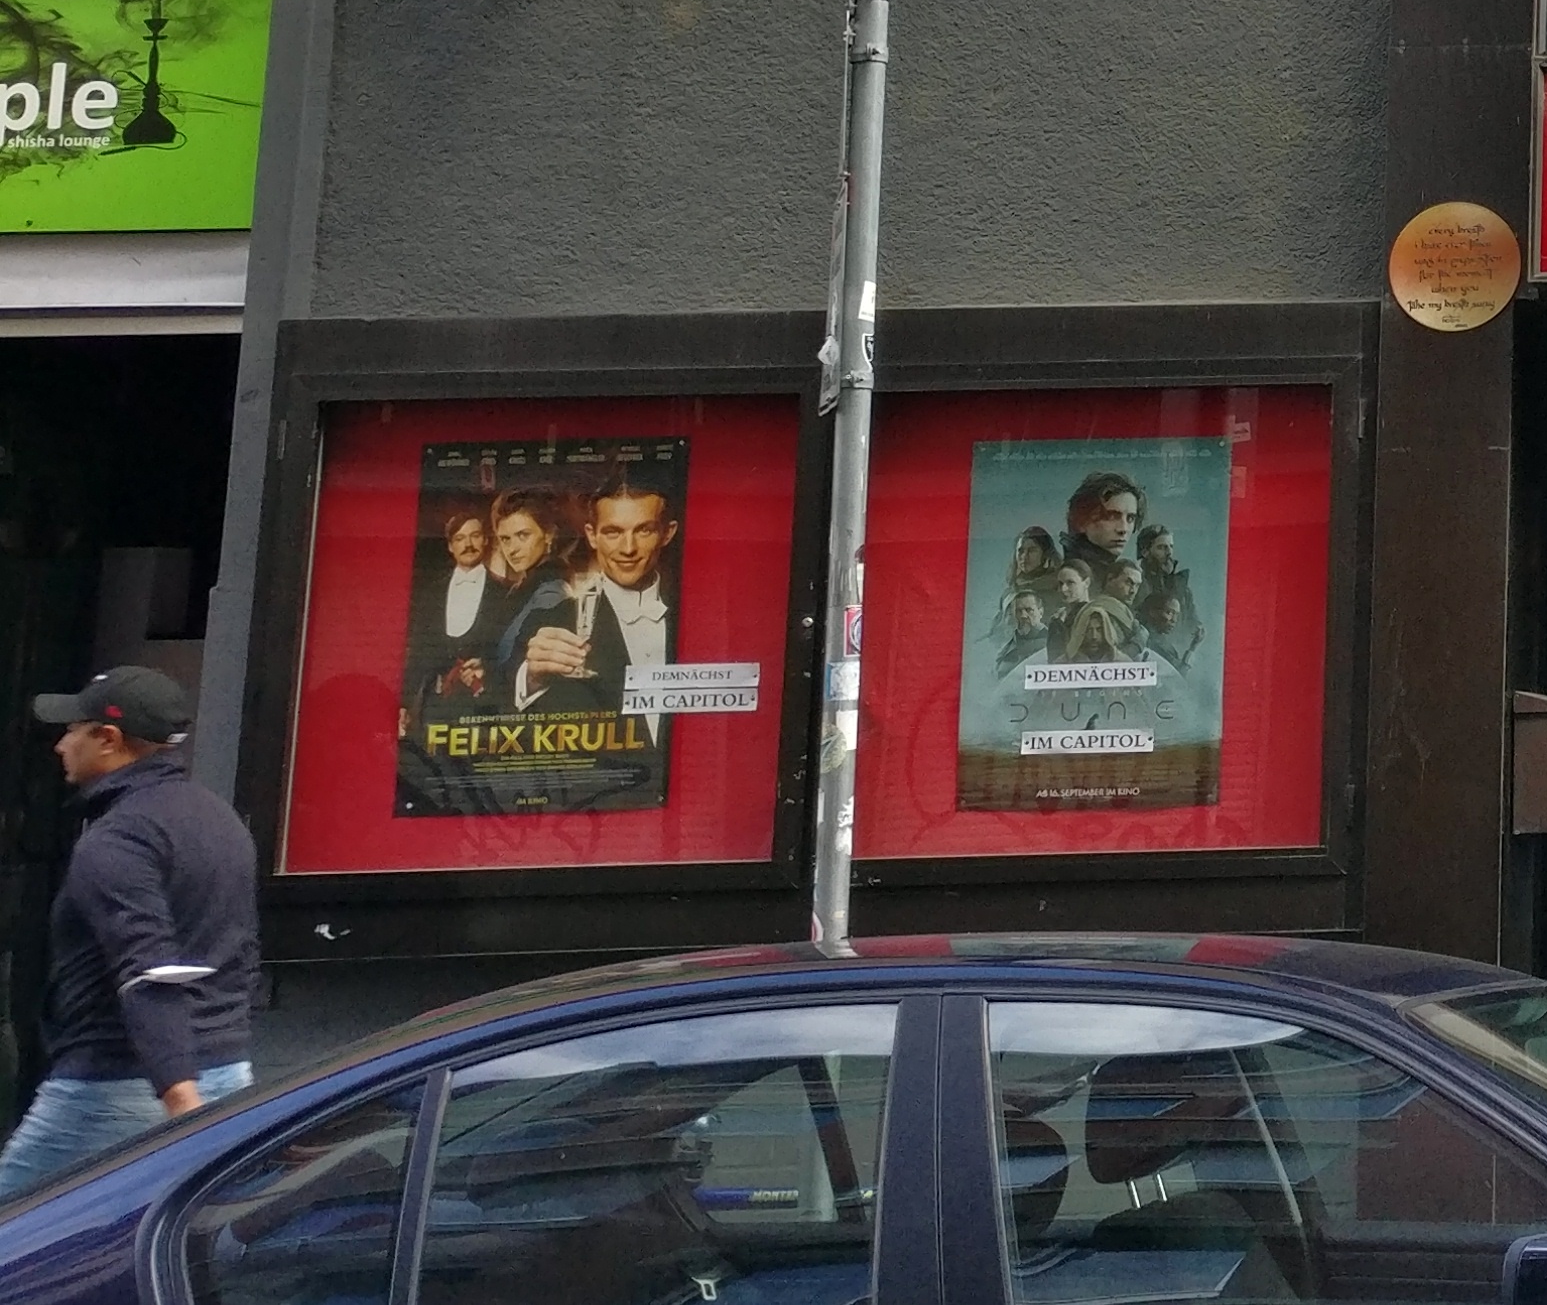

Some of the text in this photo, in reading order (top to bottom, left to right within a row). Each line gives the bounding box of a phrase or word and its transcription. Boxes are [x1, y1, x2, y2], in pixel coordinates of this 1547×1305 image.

[8, 133, 111, 148] shisha lounge
[652, 669, 733, 681] DEMNÄCHST
[1034, 665, 1150, 683] DEMNÄCHST
[631, 693, 748, 710] IM CAPITOL
[528, 712, 545, 722] DES
[426, 718, 645, 757] FELIX KRULL
[1029, 734, 1146, 750] IM CAPITOL
[1060, 787, 1104, 797] SEPTEMBER
[1117, 787, 1140, 796] KINO
